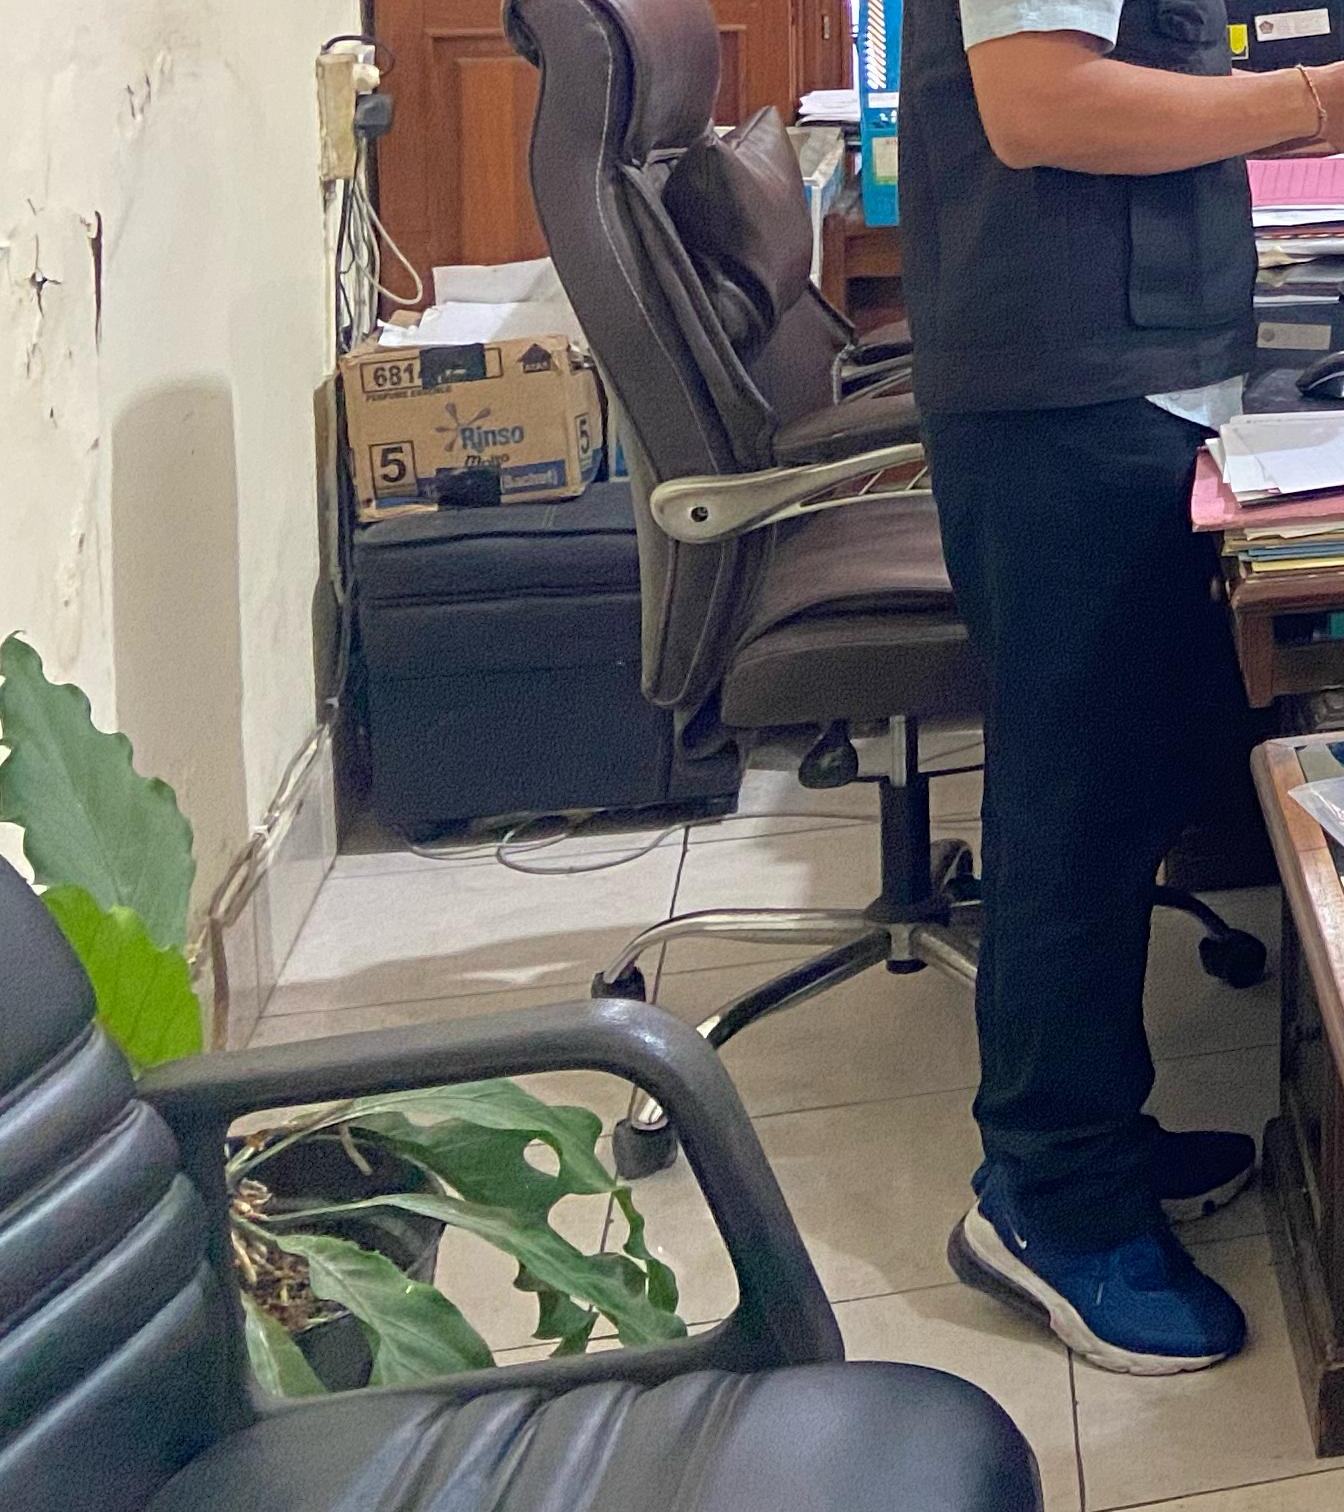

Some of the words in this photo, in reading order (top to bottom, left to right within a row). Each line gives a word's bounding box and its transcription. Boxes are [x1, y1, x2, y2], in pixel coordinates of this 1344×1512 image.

[459, 424, 525, 452] Rinso
[578, 419, 591, 453] 5
[380, 446, 406, 483] 5
